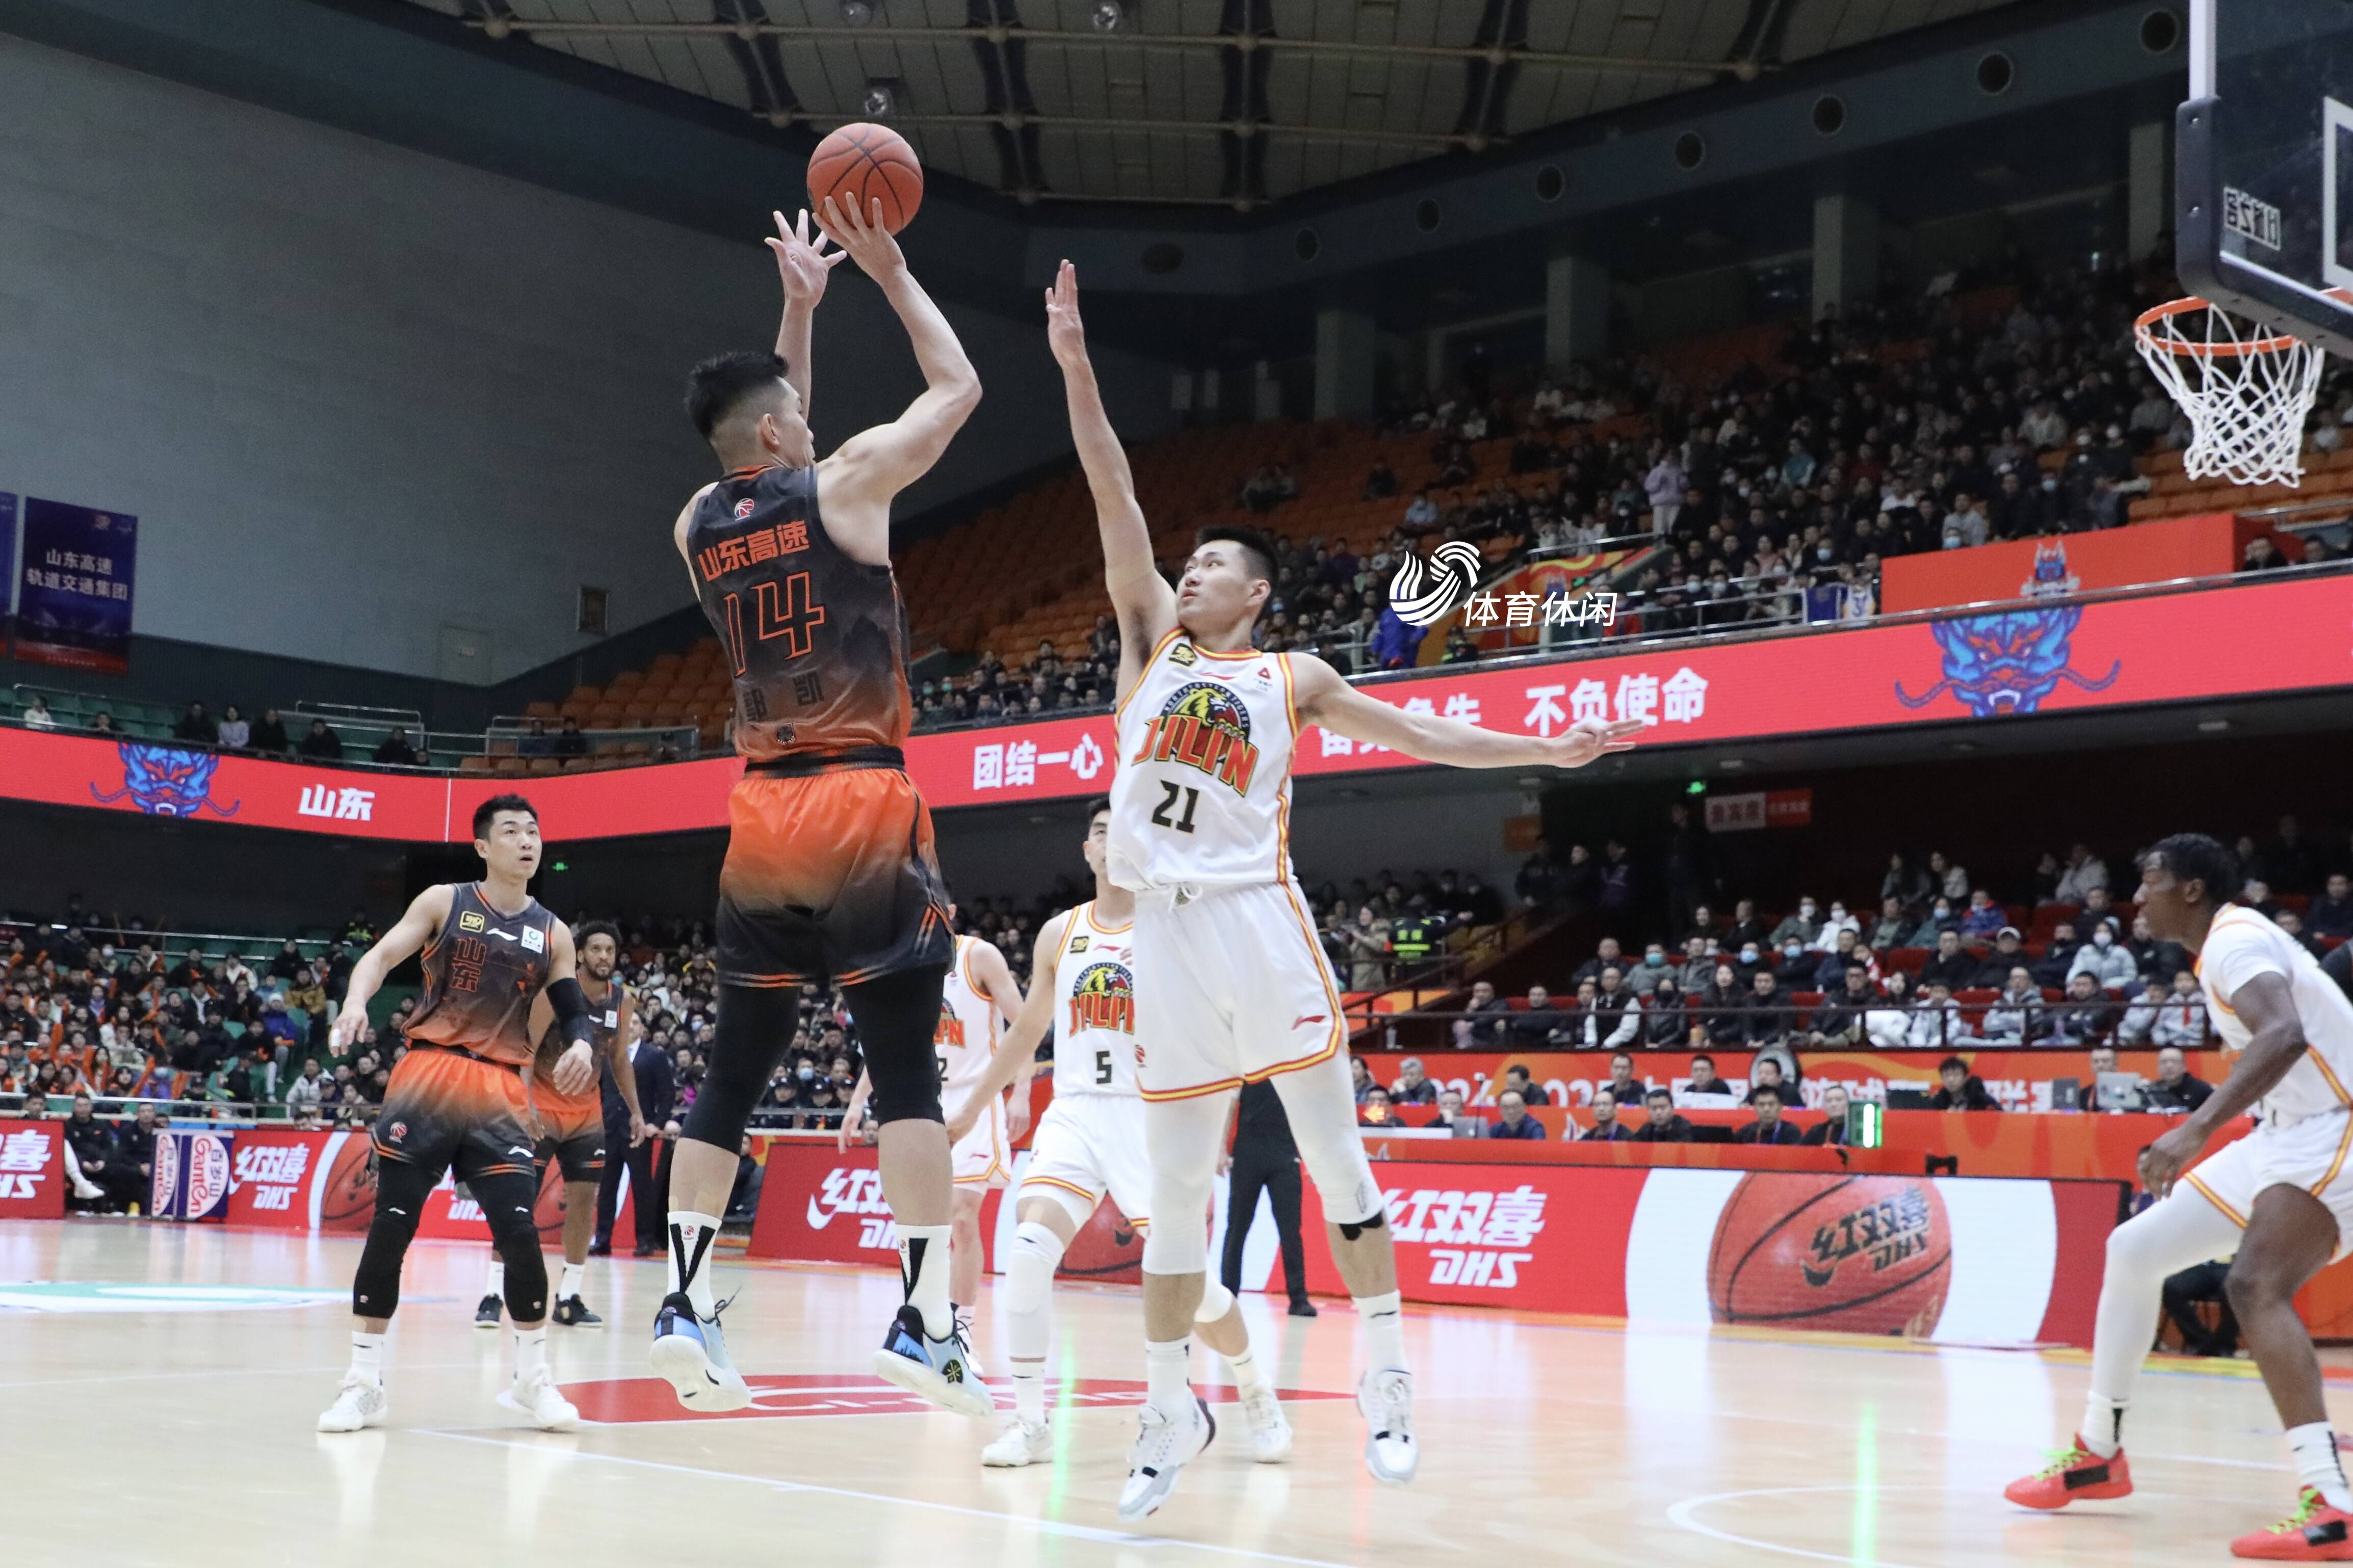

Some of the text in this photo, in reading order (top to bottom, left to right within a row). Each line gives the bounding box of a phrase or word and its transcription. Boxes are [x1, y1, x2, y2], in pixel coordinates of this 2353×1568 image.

[46, 548, 112, 575] 山东高速
[698, 520, 809, 581] 山东高速
[27, 568, 127, 601] 轨道交通集团
[724, 572, 824, 677] 14
[973, 733, 1104, 790] 团结一心
[1524, 667, 1709, 737] 不负使命
[1131, 714, 1259, 798] JILIN
[298, 784, 375, 821] 山东
[1152, 779, 1199, 834] 21
[450, 937, 487, 993] 山东
[1096, 1051, 1112, 1084] 5
[0, 1129, 51, 1172] 喜
[234, 1142, 310, 1183] 红双喜
[253, 1185, 298, 1210] DHS
[1382, 1185, 1548, 1247] 红双喜
[1811, 1185, 1929, 1263] 红双喜
[1429, 1249, 1533, 1289] DHS
[1868, 1229, 1927, 1272] DHS
